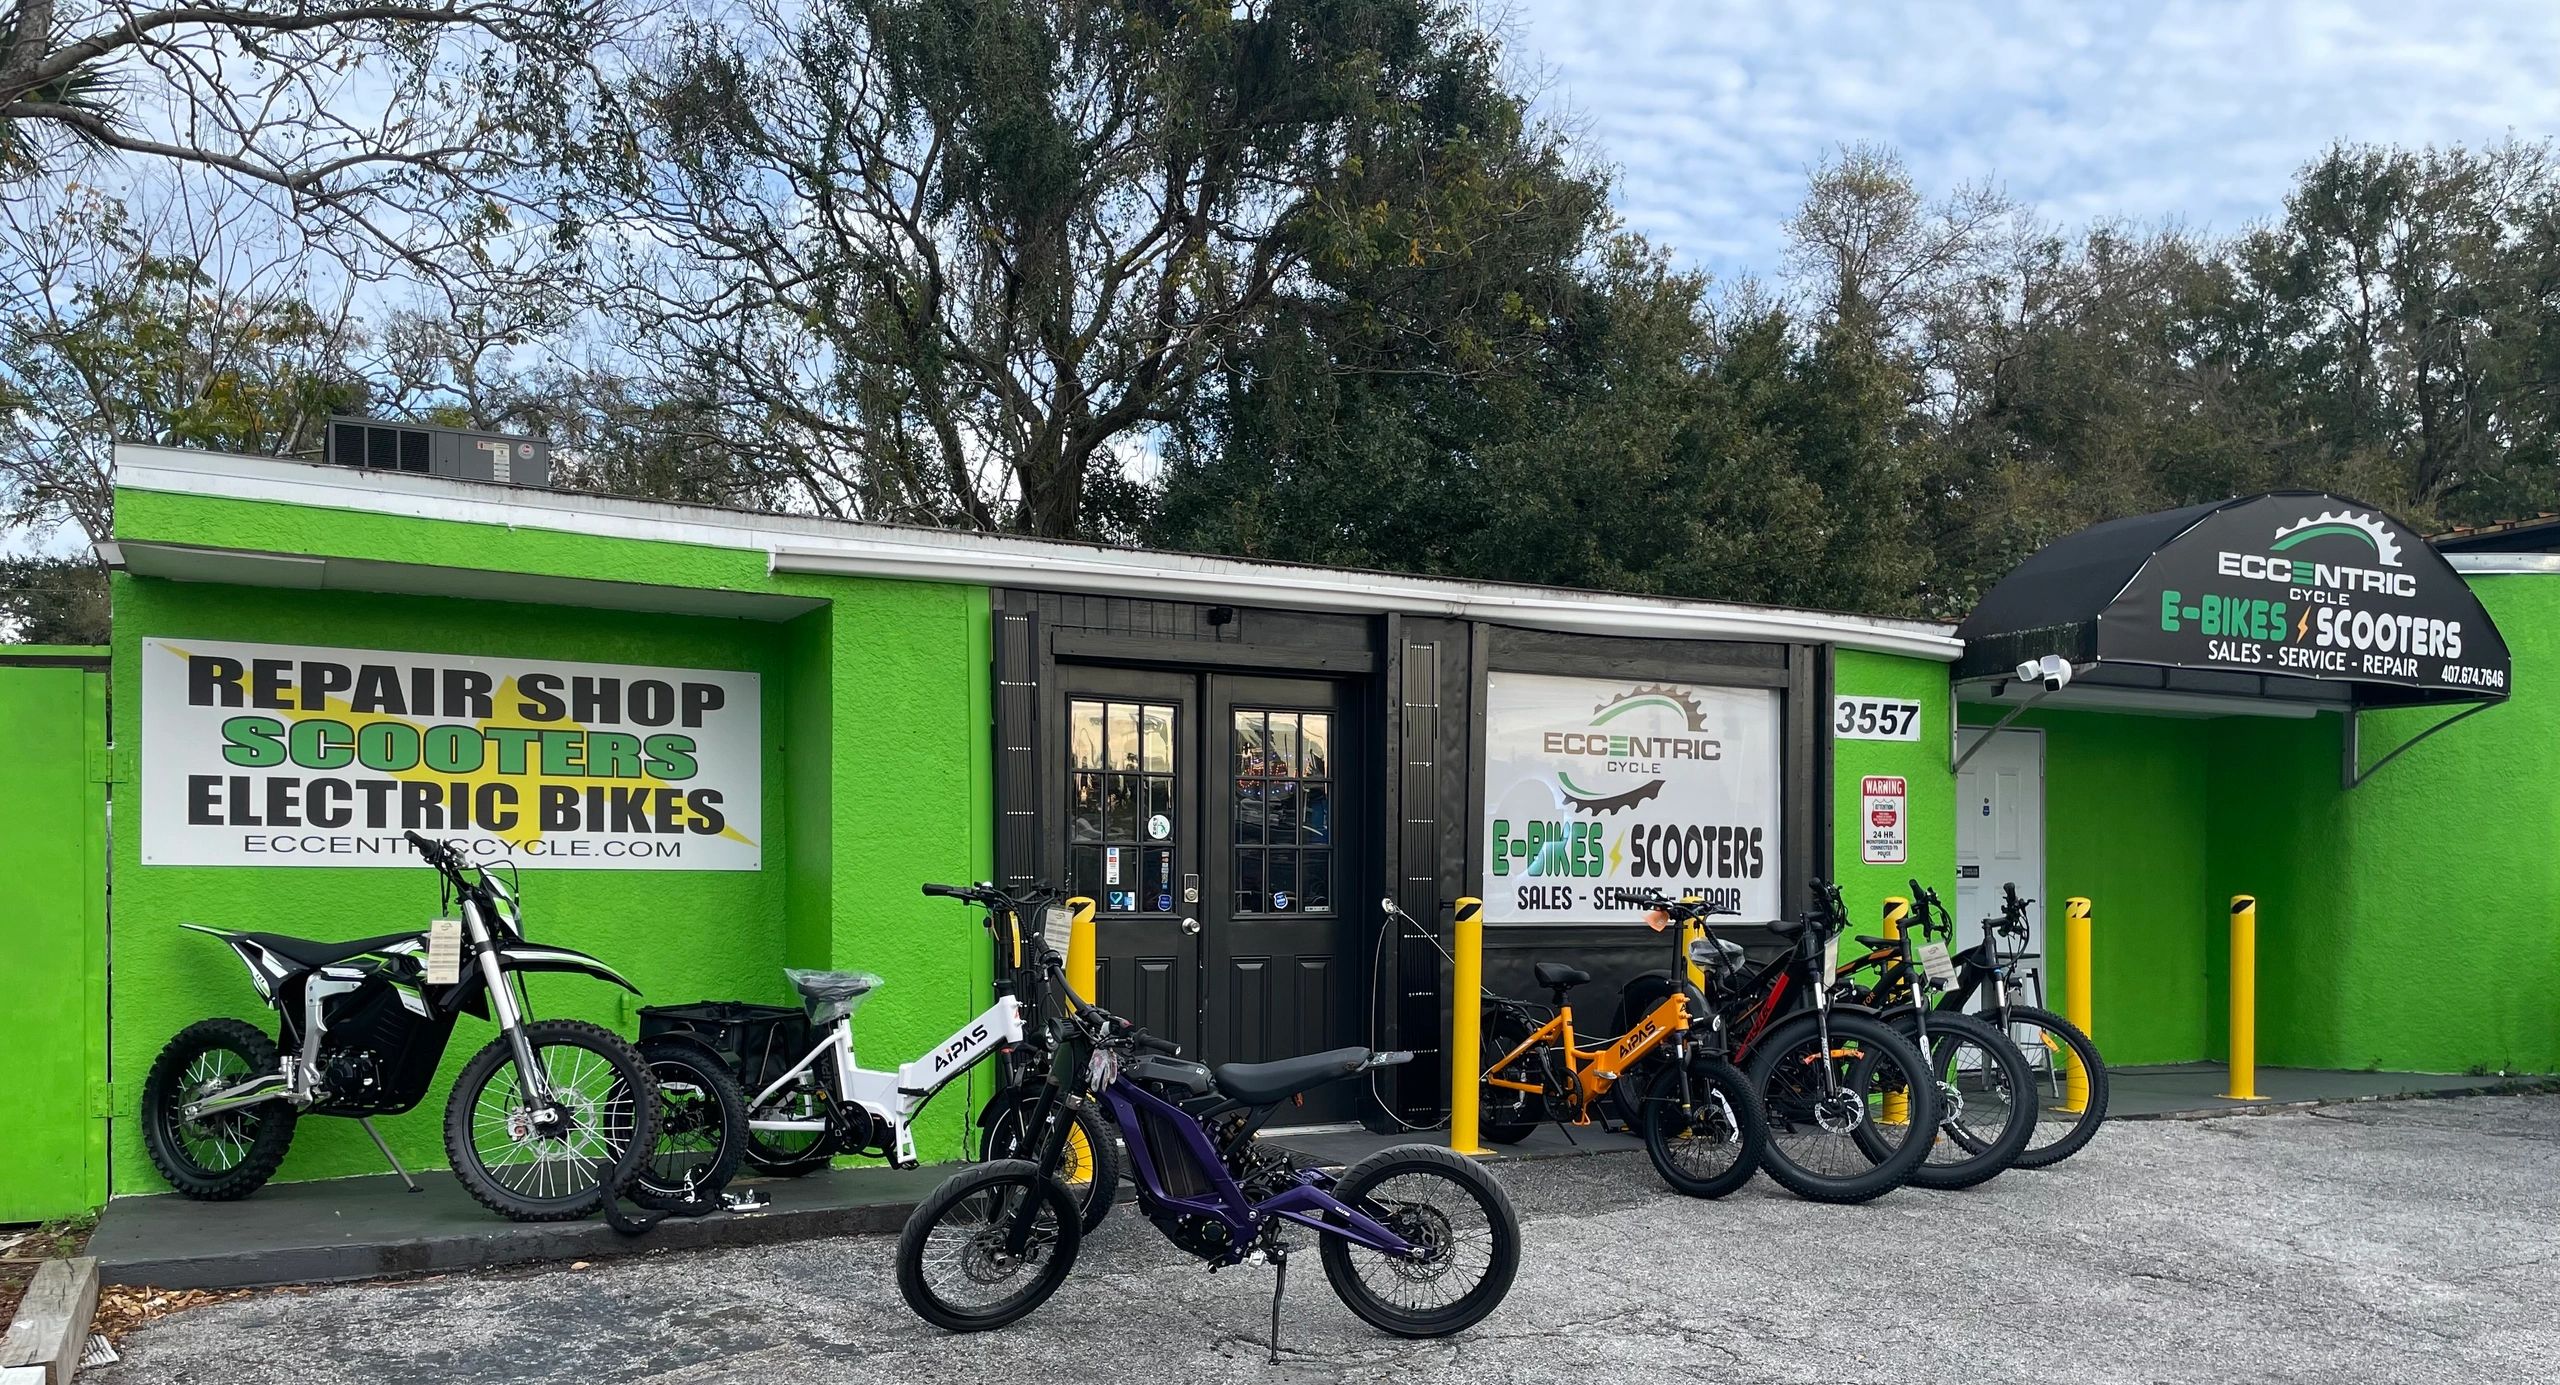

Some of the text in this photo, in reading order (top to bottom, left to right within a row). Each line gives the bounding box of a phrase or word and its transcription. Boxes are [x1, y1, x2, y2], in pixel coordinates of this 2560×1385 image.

[2218, 551, 2416, 597] ECCENTRIC
[2290, 588, 2350, 606] CYCLE
[2162, 590, 2461, 659] E-BIKES SCOOTERS
[2208, 639, 2261, 663] SALES
[2278, 646, 2346, 671] SERVICE
[2363, 654, 2418, 677] REPAIR
[188, 655, 725, 728] REPAIR SHOP
[2441, 664, 2504, 688] 407.674.7646
[1836, 702, 1918, 735] 3557
[221, 716, 698, 780] SCOOTERS
[1544, 732, 1721, 761] ECCENTRIC
[1607, 761, 1661, 774] CYCLE
[1866, 780, 1902, 794] WARNING
[188, 775, 725, 835] ELECTRIC BIKES
[244, 835, 681, 857] ECCENTCCYCLE.COM
[1492, 819, 1763, 878] E-BIKES SCOOTERS
[1517, 885, 1572, 910] SALES
